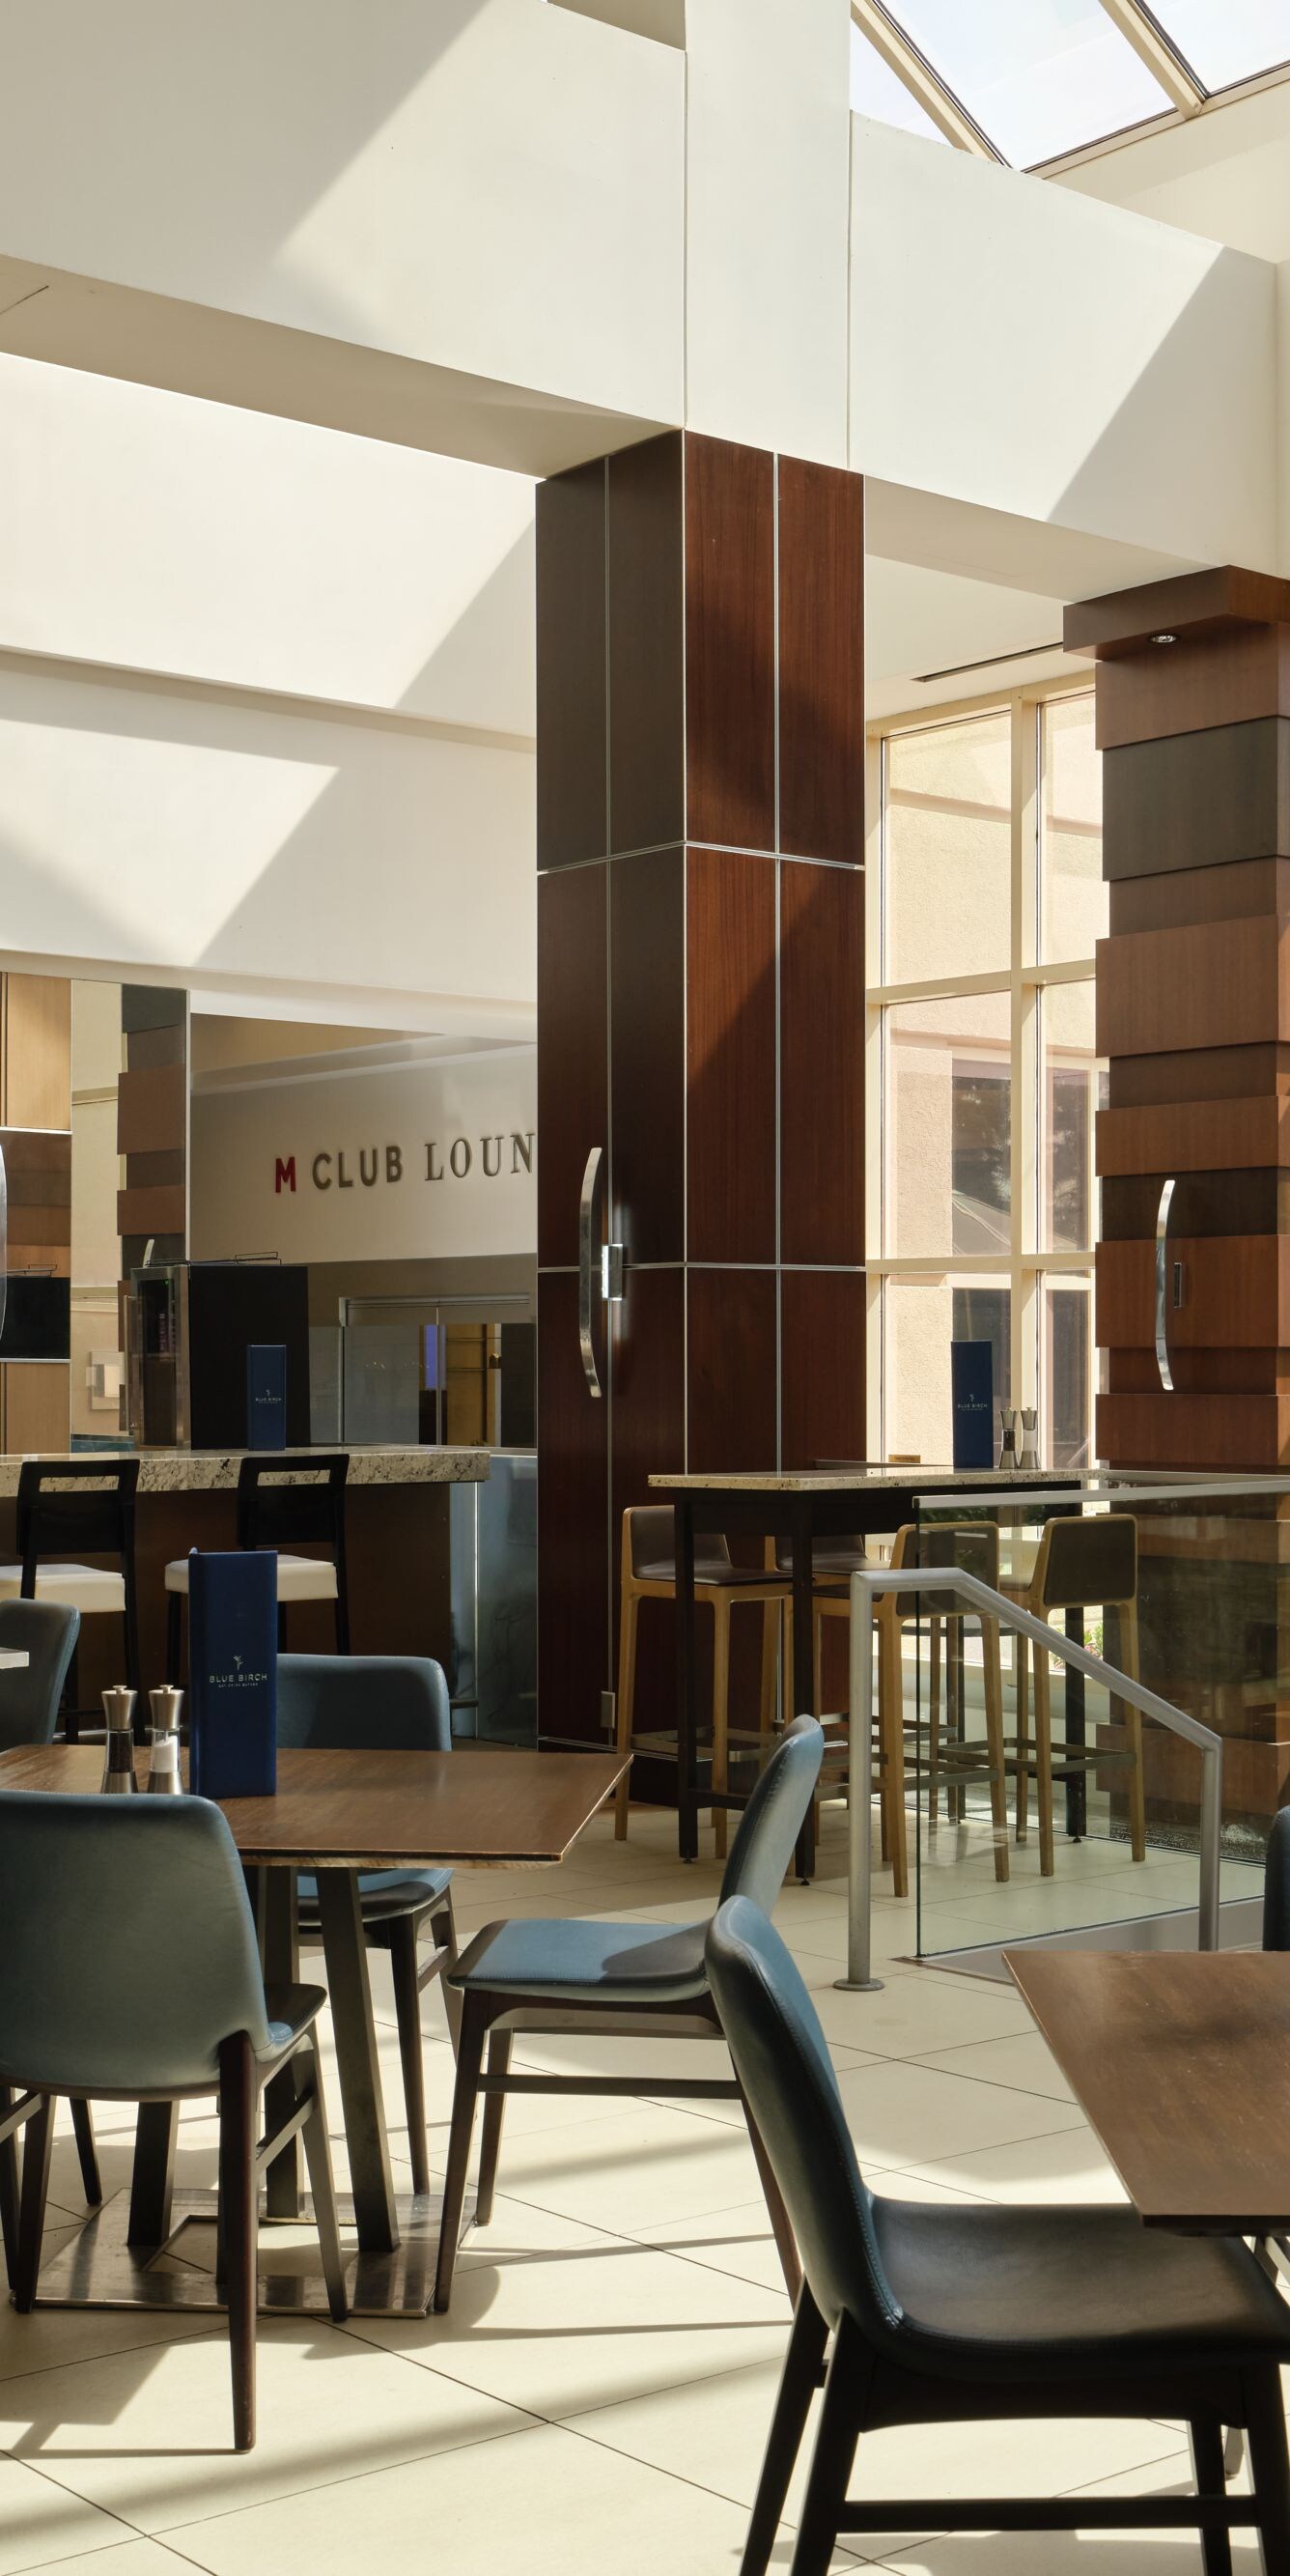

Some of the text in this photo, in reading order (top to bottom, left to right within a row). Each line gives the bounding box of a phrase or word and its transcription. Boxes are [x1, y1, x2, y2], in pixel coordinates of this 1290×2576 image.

[274, 1133, 536, 1193] M CLUB LOUN
[209, 1673, 267, 1684] BLUE BIRCH
